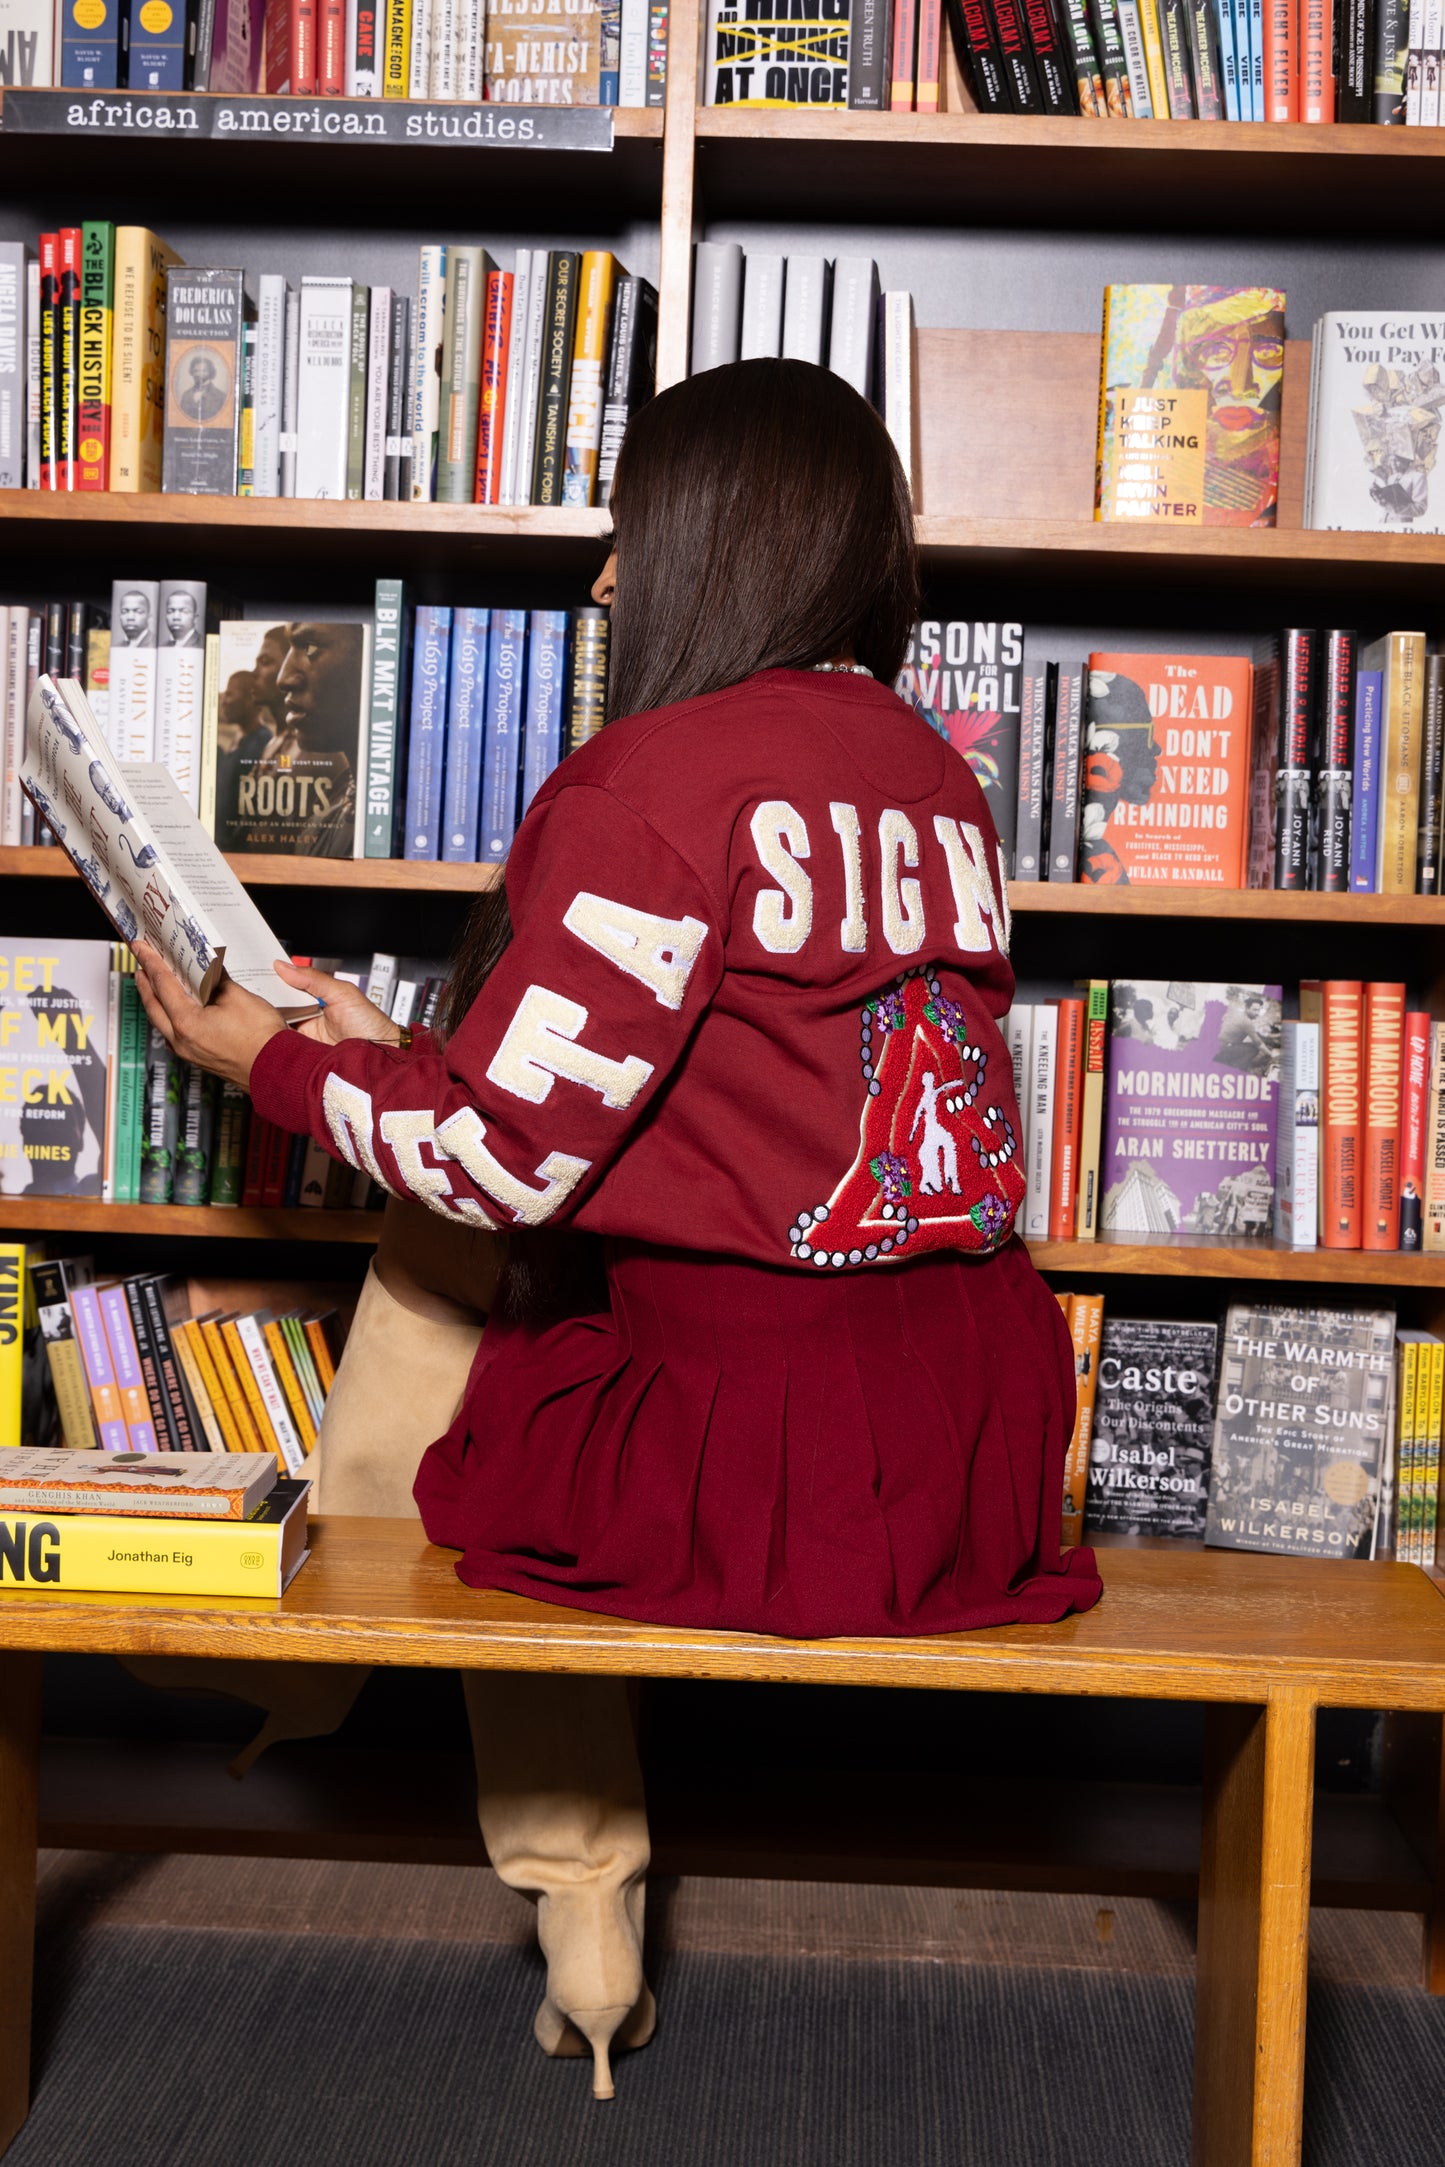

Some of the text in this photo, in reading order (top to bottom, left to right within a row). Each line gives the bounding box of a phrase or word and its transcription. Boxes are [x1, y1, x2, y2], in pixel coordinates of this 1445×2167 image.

[358, 11, 373, 57] CANE
[650, 7, 668, 83] PROJECT
[716, 27, 849, 62] NOTHING
[862, 27, 874, 67] TRUTH
[1196, 11, 1212, 88] HEATHER MCGHEE
[390, 56, 402, 79] GOD
[485, 42, 587, 74] TA-NEHISI
[1124, 12, 1147, 101] THE COLOR OF WATER
[1226, 55, 1235, 85] VIBE
[1240, 56, 1249, 86] VIBE
[1254, 56, 1263, 86] VIBE
[1274, 50, 1289, 97] FLYER
[1307, 50, 1322, 98] FLYER
[494, 79, 573, 104] COATES
[714, 67, 848, 104] AT ONCE
[980, 57, 997, 102] ALEX HALEY
[1355, 55, 1364, 97] MISSISSIPPI
[67, 100, 544, 140] african american studies.
[85, 259, 104, 270] THE
[172, 287, 235, 305] FREDERICK
[622, 282, 631, 313] HENRY
[122, 266, 135, 384] WE REFUSE TO BE SILENT
[175, 307, 233, 325] DOUGLASS
[177, 329, 230, 337] COLLECTION
[551, 260, 570, 378] OUR SECRET SOCIETY
[618, 316, 629, 344] LOUIS
[1336, 322, 1415, 340] You Get
[82, 273, 104, 420] BLACK HISTORY
[414, 260, 431, 432] will scream to the world
[615, 346, 627, 380] GATES,
[1344, 346, 1425, 367] You Pay
[42, 310, 54, 457] LIES ABOUT BLACK PEOPLE
[1132, 398, 1177, 412] JUST
[370, 366, 383, 483] YOU ARE YOUR BEST THING
[1119, 433, 1198, 449] TALKING
[541, 404, 558, 503] TANISHA C. FORD
[1116, 500, 1197, 517] PAINTER
[422, 618, 442, 731] The 1619 Project
[496, 622, 518, 735] The 1619 Project
[980, 664, 998, 677] FOR
[1164, 665, 1197, 678] The
[368, 608, 398, 816] BLK MKT VINTAGE
[1149, 684, 1233, 720] DEAD
[1290, 636, 1309, 765] MEDGAR & MYRLIE
[1030, 676, 1044, 819] WHEN CRACK WAS KING
[1166, 729, 1232, 758] DON'T
[1361, 686, 1375, 792] Practicing New Worlds
[237, 776, 332, 818] ROOTS
[1160, 766, 1229, 795] NEED
[1114, 802, 1229, 829] REMINDING
[246, 834, 318, 845] ALEX HALEY
[1281, 828, 1290, 856] REID
[1292, 814, 1302, 867] JOY-ANN
[750, 800, 1011, 957] SIGM
[1127, 866, 1224, 882] JULIAN RANDALL
[38, 1013, 94, 1050] MY
[1329, 1007, 1359, 1037] AM
[1088, 1020, 1105, 1073] ASSATA
[1038, 1045, 1049, 1090] KNEELING
[1328, 1042, 1359, 1127] MAROON
[1117, 1070, 1272, 1101] MORNINGSIDE
[26, 1109, 66, 1120] REFORM
[1036, 1094, 1047, 1115] MAN
[150, 1108, 165, 1148] HYLTON
[24, 1146, 72, 1161] HINES
[1115, 1136, 1270, 1162] ARAN SHETTERLY
[1062, 1144, 1072, 1208] SHAKA SENGHOR
[1340, 1137, 1355, 1209] RUSSELL SHOATZ
[0, 1256, 20, 1345] KING
[1074, 1305, 1087, 1345] WILEY
[1088, 1308, 1101, 1344] MAYA
[1233, 1336, 1277, 1359] THE
[1284, 1341, 1386, 1371] WARMTH
[1100, 1358, 1197, 1395] Caste
[1291, 1375, 1320, 1394] OF
[1101, 1416, 1205, 1434] Our Discontents
[1225, 1394, 1381, 1431] OTHER SUNS
[1073, 1406, 1091, 1478] REMEMBER,
[1111, 1444, 1175, 1467] Isabel
[1230, 1433, 1369, 1457] AMERICA'S GREAT MIGRATION
[28, 1490, 102, 1501] GENGHIS KHAN
[1090, 1468, 1196, 1493] Wilkerson
[148, 1500, 194, 1508] WEATHERFORD
[1250, 1497, 1336, 1520] ISABEL
[1220, 1518, 1360, 1548] WILKERSON
[108, 1550, 193, 1566] Jonathan Eig
